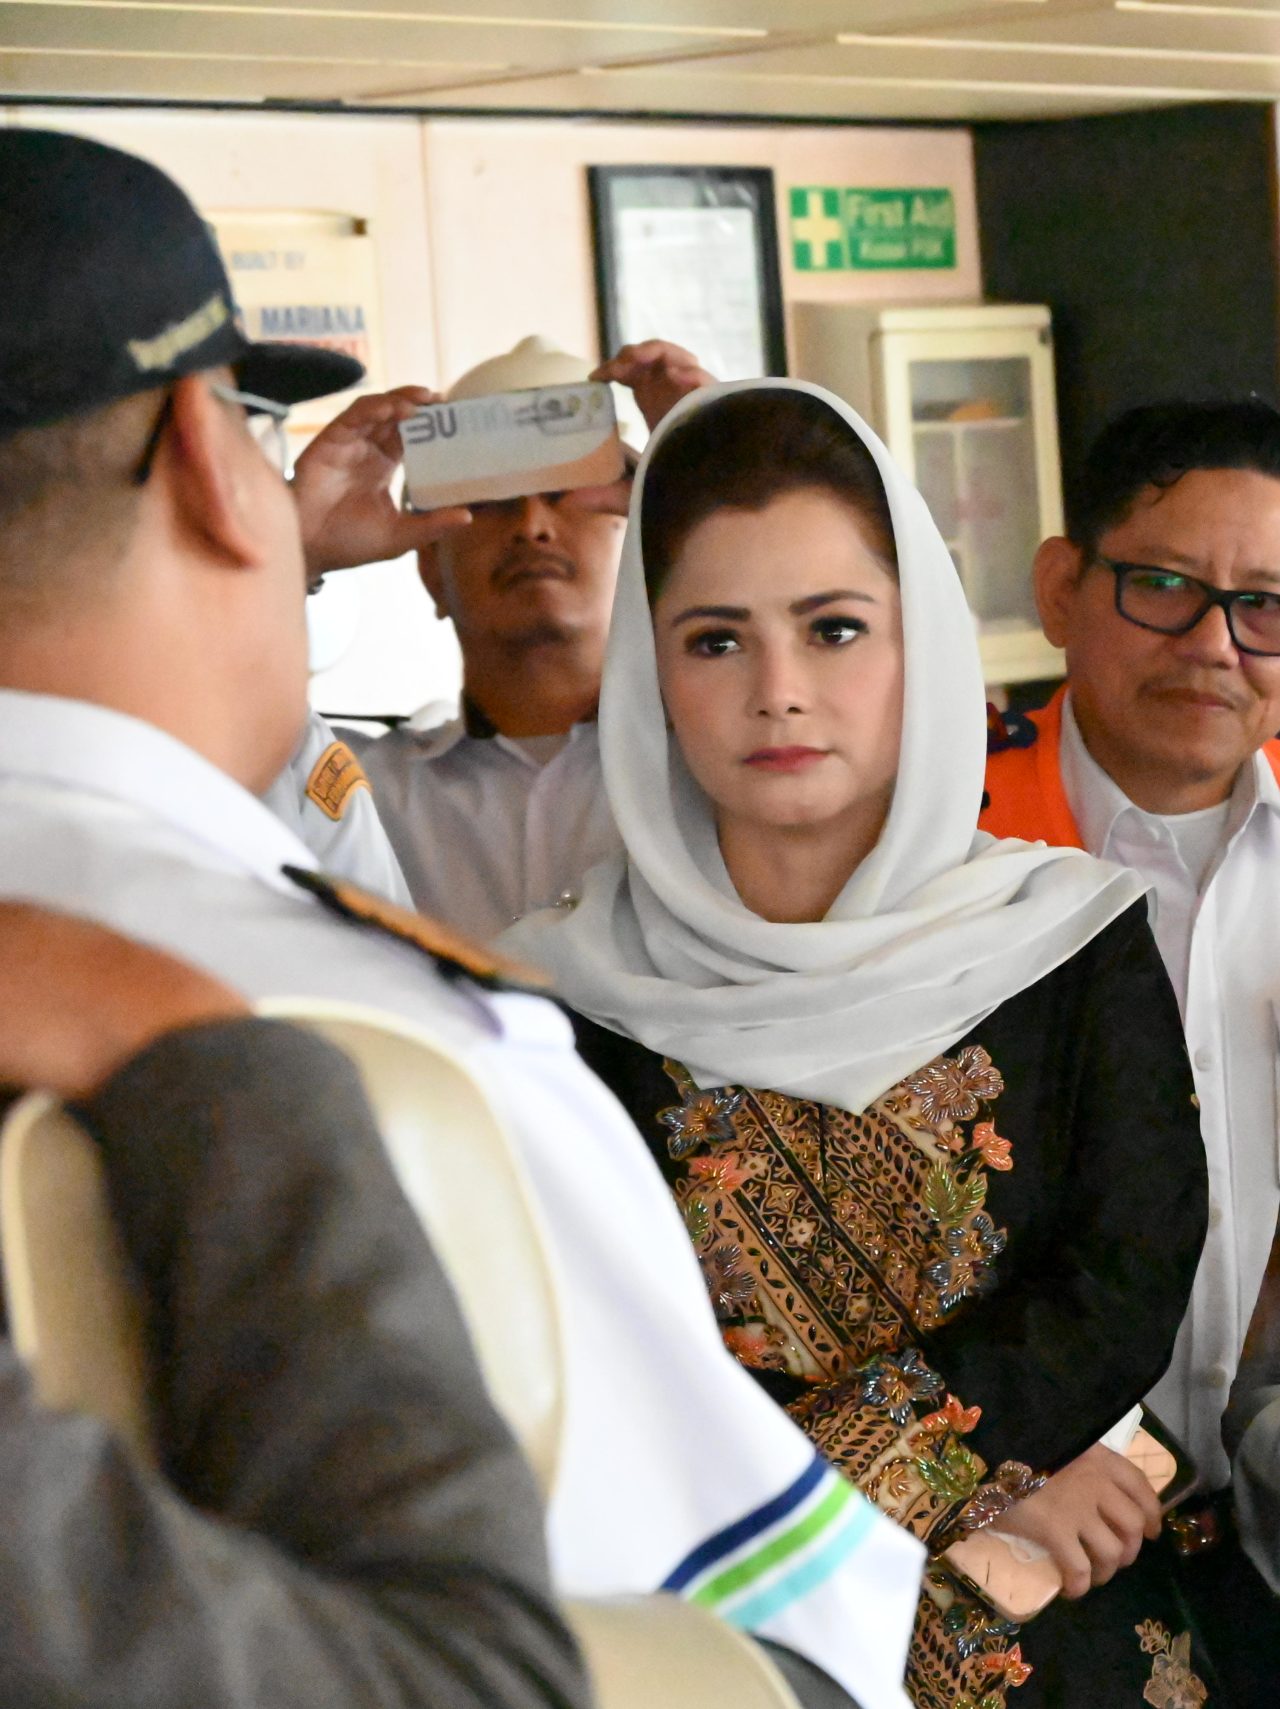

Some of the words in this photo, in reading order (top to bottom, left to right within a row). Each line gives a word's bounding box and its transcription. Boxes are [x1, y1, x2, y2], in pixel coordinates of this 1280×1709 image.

[847, 193, 905, 229] First
[910, 193, 955, 228] Aid
[260, 304, 366, 336] MARIANA
